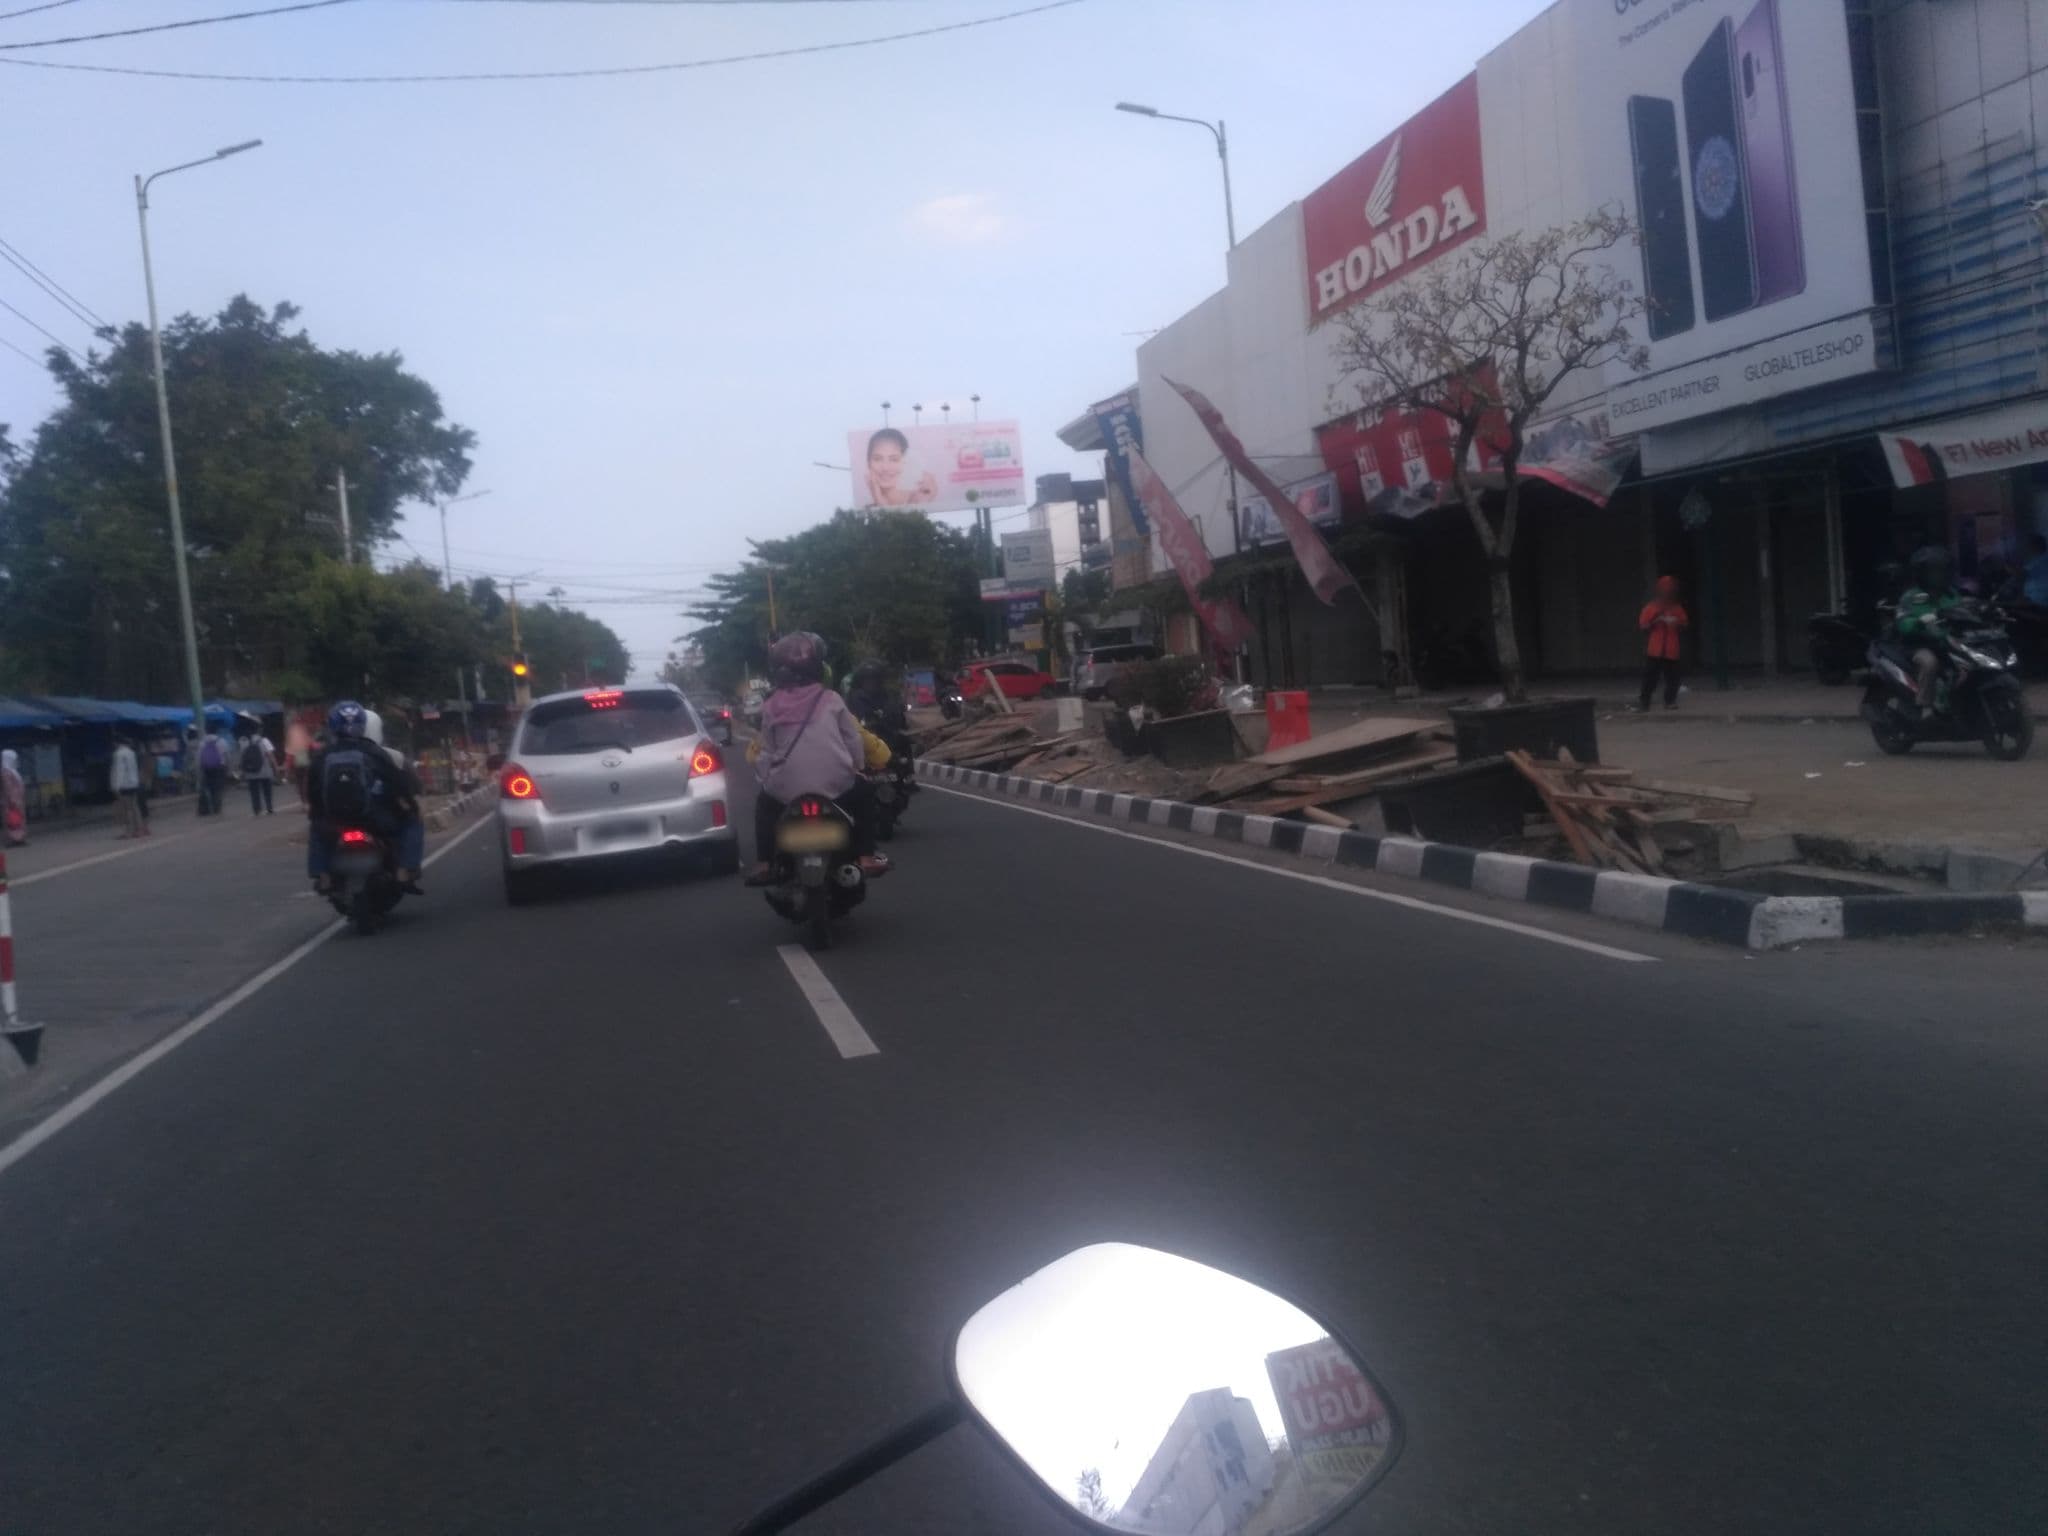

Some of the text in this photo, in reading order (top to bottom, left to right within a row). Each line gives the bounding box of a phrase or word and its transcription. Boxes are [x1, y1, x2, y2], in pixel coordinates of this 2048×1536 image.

[1315, 185, 1478, 312] HONDA
[1611, 334, 1864, 419] EXCELLENT PARTNER GLOBALTELESHOP
